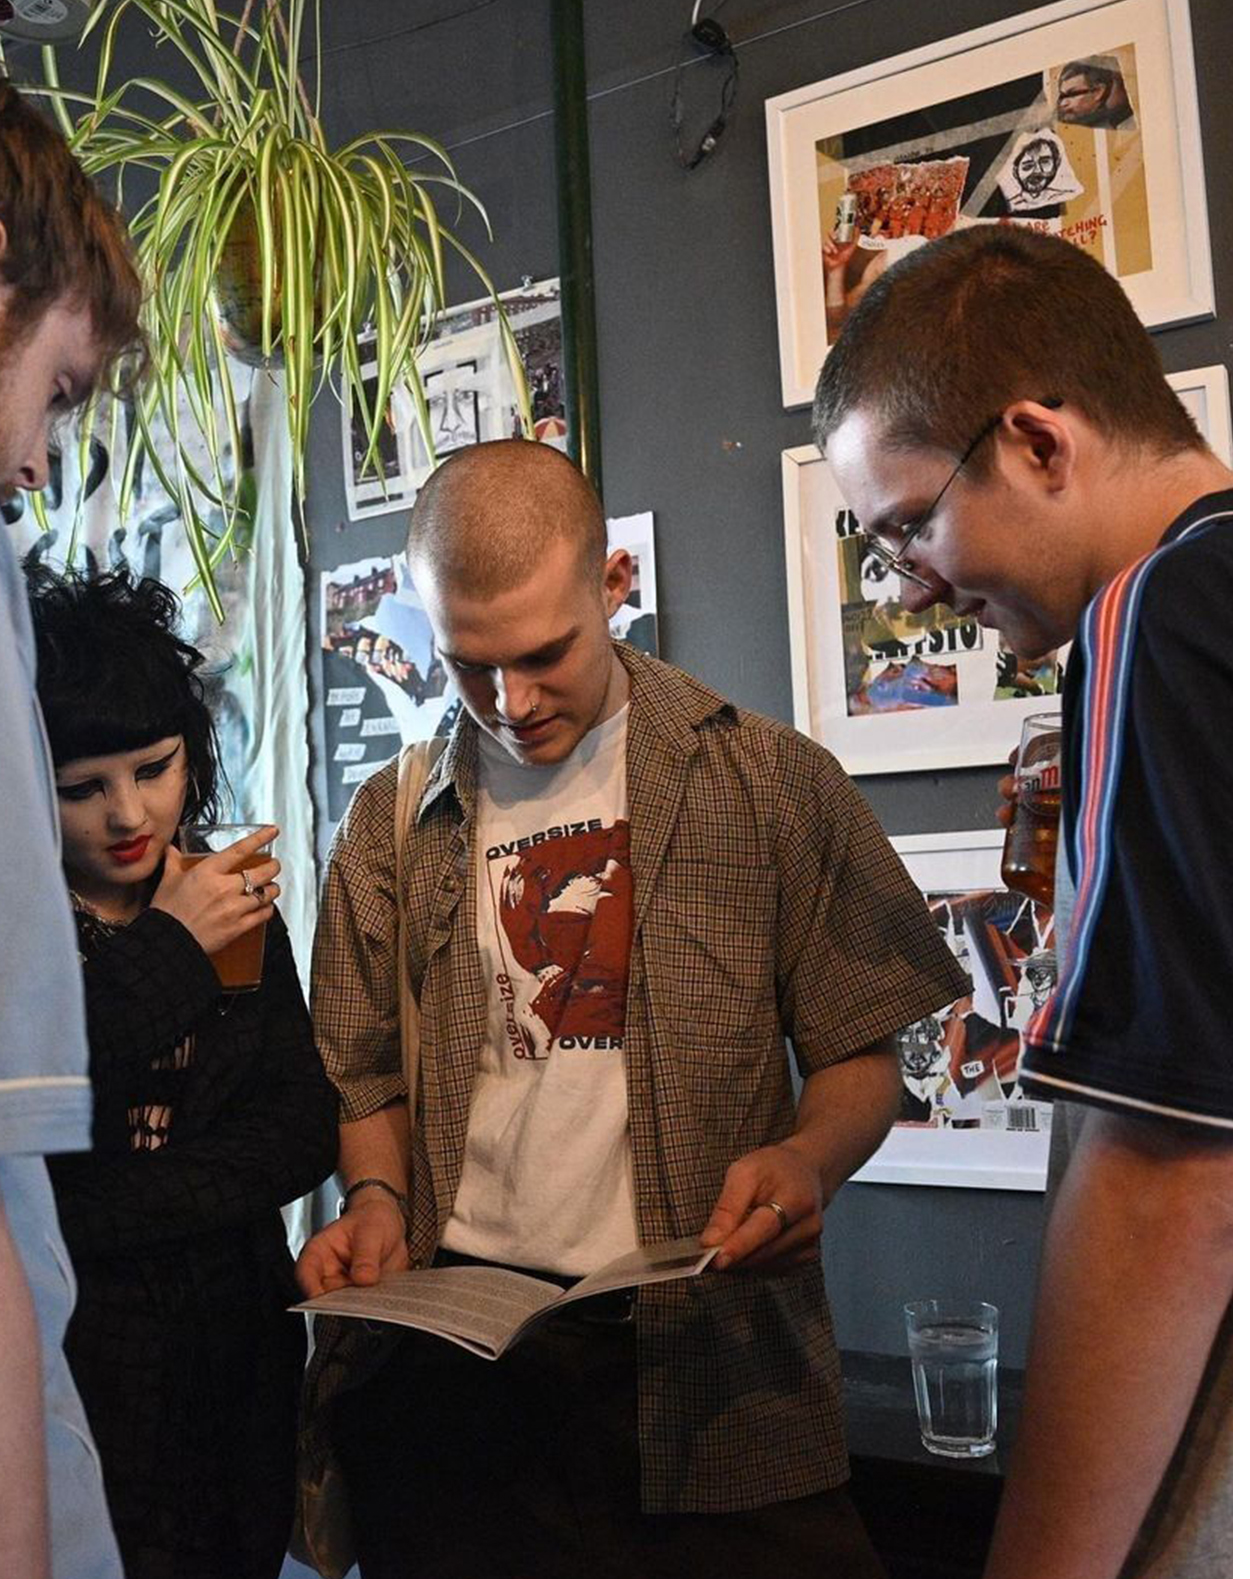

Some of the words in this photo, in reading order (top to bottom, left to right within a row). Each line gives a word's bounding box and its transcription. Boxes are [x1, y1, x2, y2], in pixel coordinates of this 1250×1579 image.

[486, 818, 602, 861] OVERSIZE
[496, 974, 526, 1060] oversize
[559, 1035, 624, 1050] OVER
[963, 1064, 980, 1074] THE
